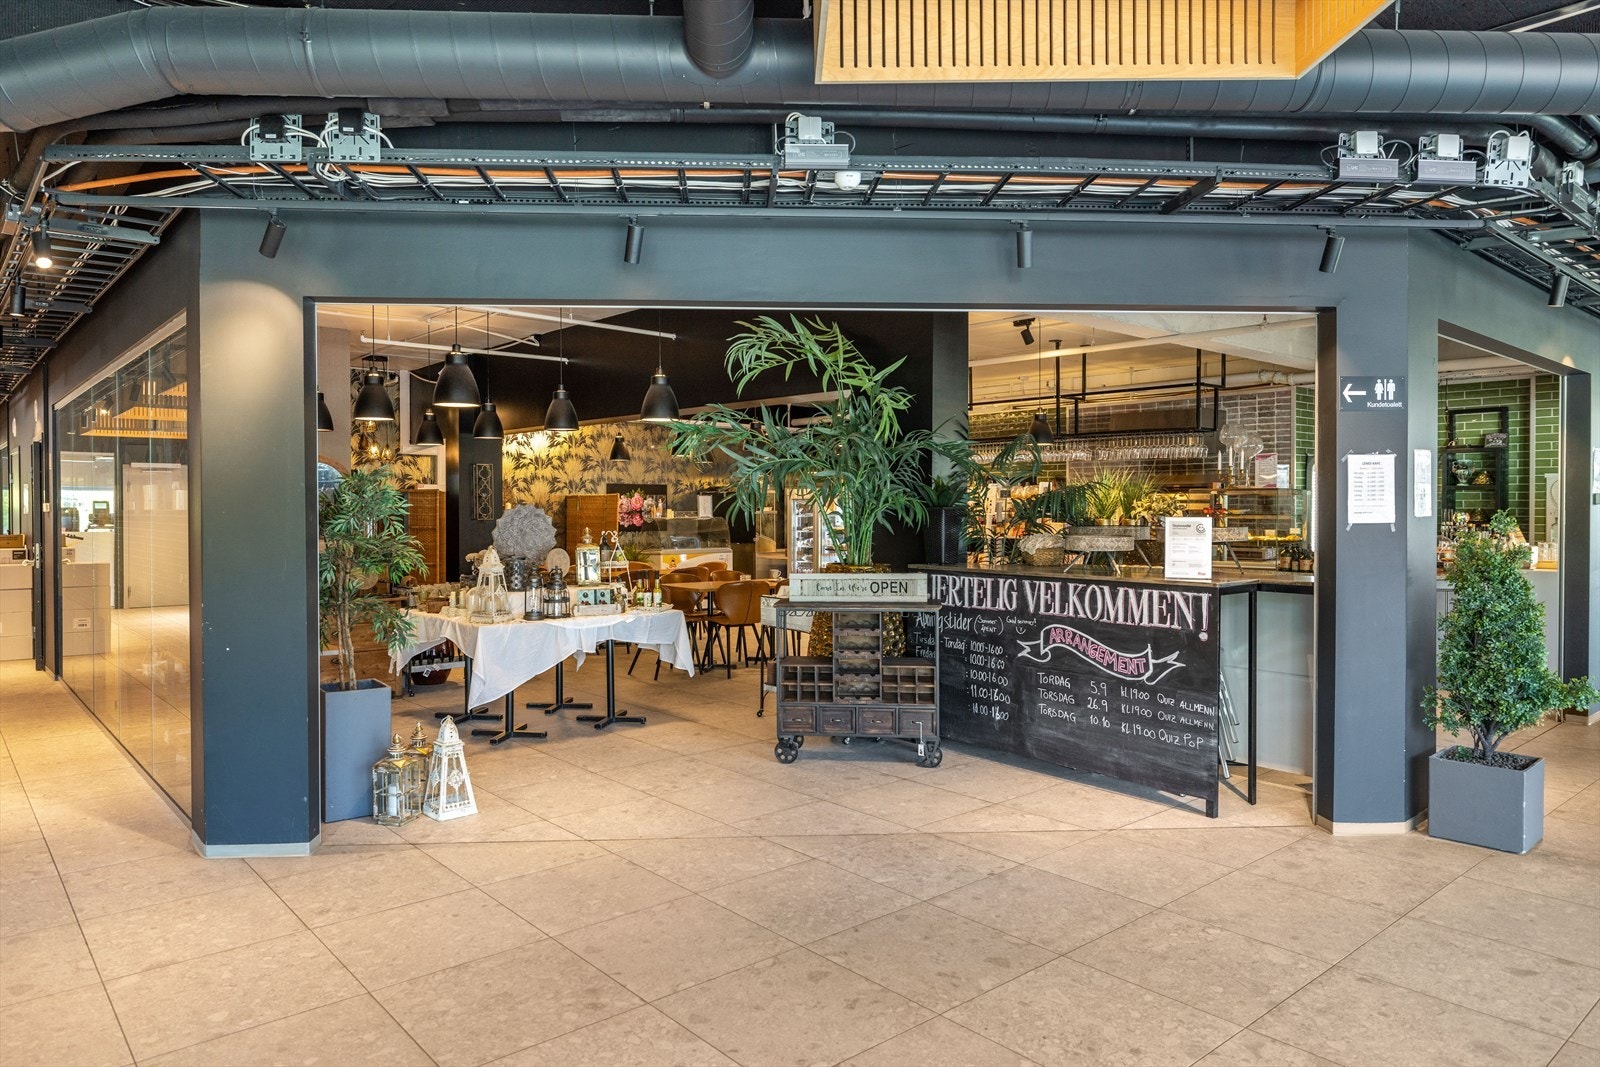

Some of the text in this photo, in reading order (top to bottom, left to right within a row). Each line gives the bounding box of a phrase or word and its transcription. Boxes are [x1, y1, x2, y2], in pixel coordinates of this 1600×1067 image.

[870, 581, 908, 594] OPEN
[1022, 579, 1212, 642] VELKOMMEN!
[913, 631, 936, 646] Tirsda
[1049, 627, 1147, 675] ARRANGEMENT
[1090, 680, 1107, 697] 5.9
[1037, 687, 1075, 705] TORSDAG
[1087, 696, 1108, 713] 26.9
[1038, 703, 1077, 724] TORSDAG
